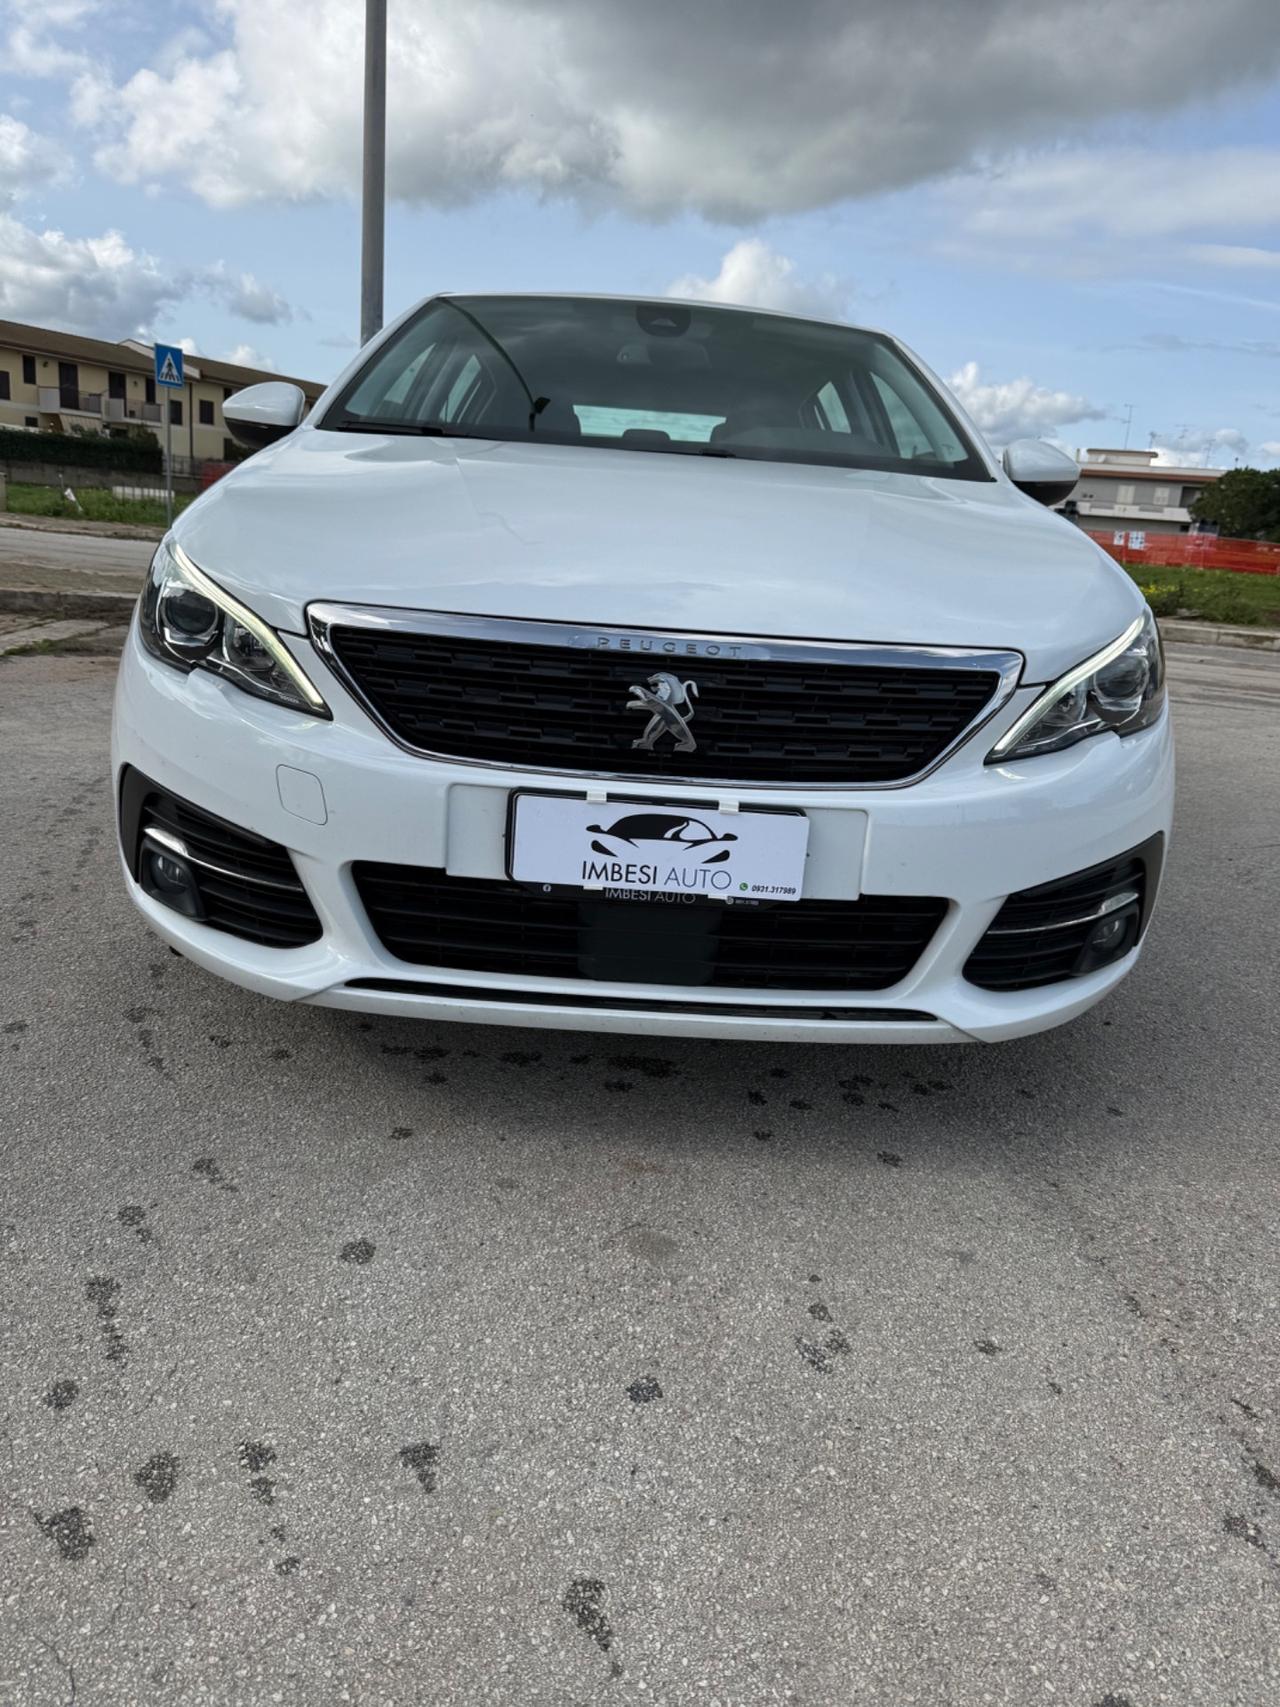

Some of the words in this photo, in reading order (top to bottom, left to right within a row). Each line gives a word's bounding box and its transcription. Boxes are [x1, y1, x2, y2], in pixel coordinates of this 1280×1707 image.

[597, 637, 742, 657] PEUGEOT
[581, 860, 658, 885] IMBESI
[664, 867, 732, 890] AUTO
[604, 887, 652, 901] IMBESI
